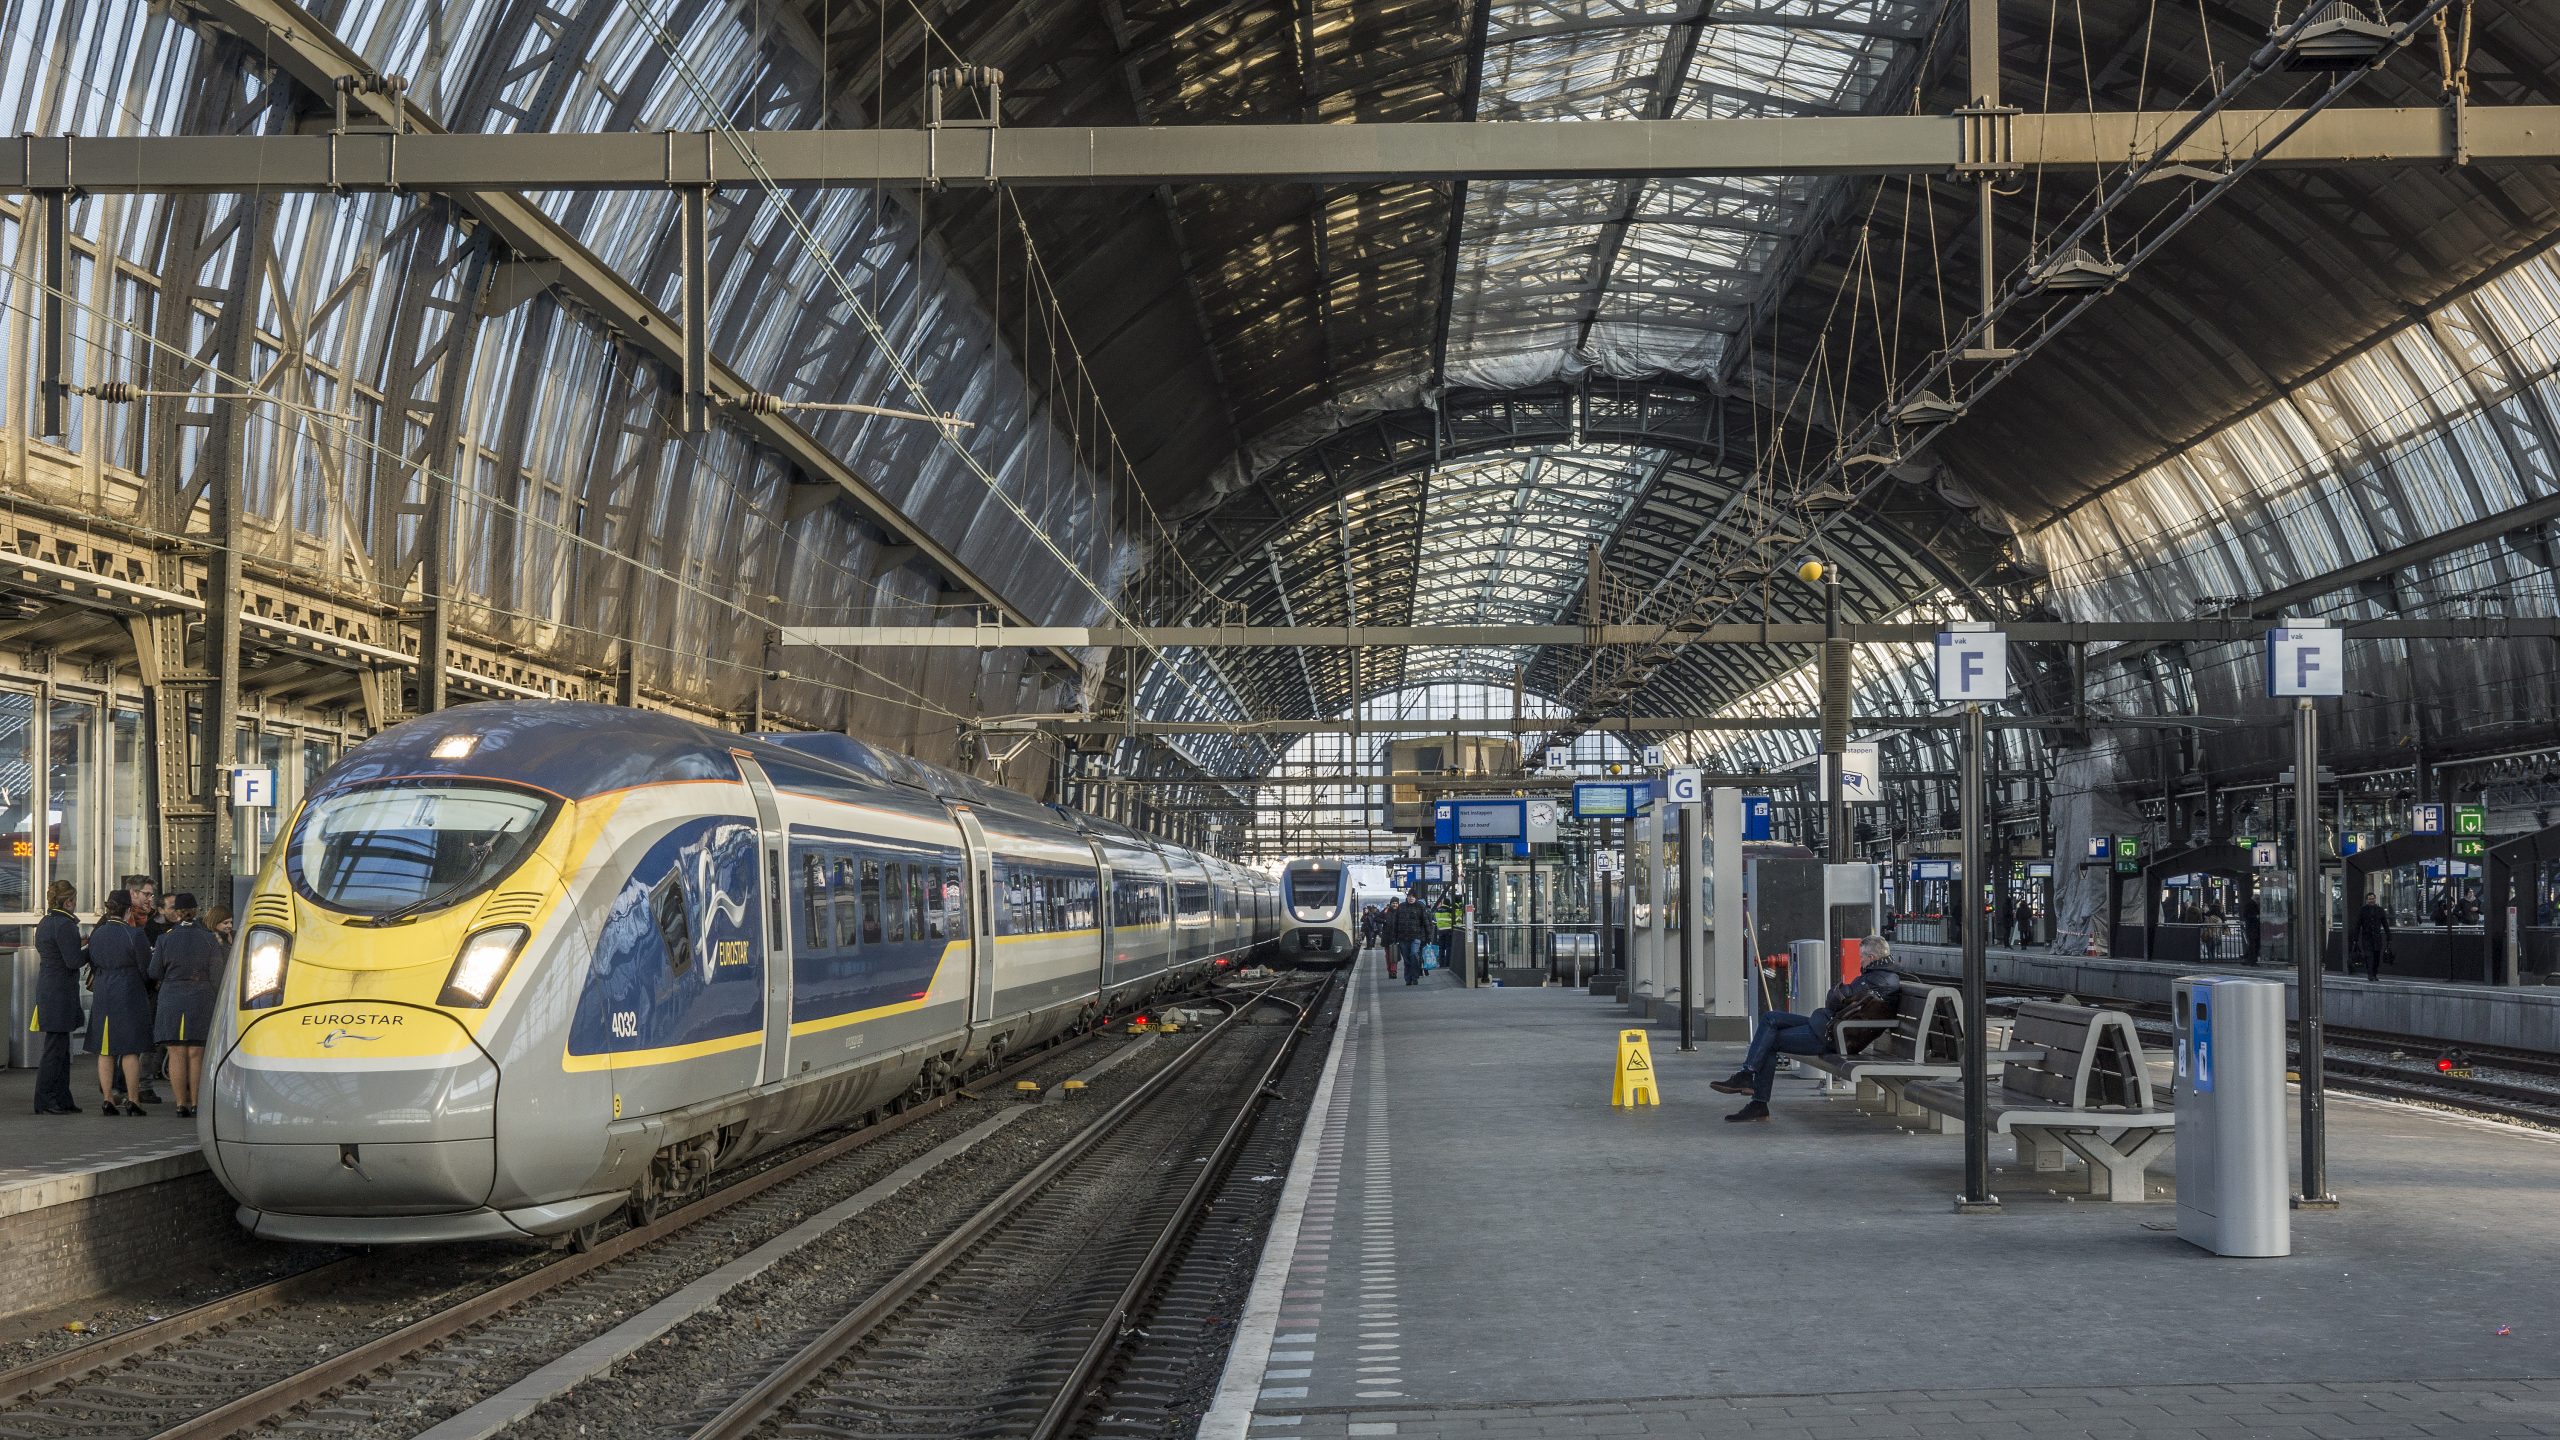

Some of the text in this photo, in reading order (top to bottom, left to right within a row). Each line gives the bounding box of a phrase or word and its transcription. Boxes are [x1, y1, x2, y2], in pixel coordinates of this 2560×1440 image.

[1961, 651, 1984, 693] F
[2297, 647, 2320, 688] F
[1551, 752, 1562, 765] H
[1648, 751, 1659, 764] H
[246, 780, 259, 802] F
[1675, 778, 1693, 799] G
[720, 940, 749, 966] EUROSTAR
[301, 1014, 404, 1026] EUROSTAR
[611, 1011, 638, 1038] 4032
[615, 1098, 620, 1113] 3
